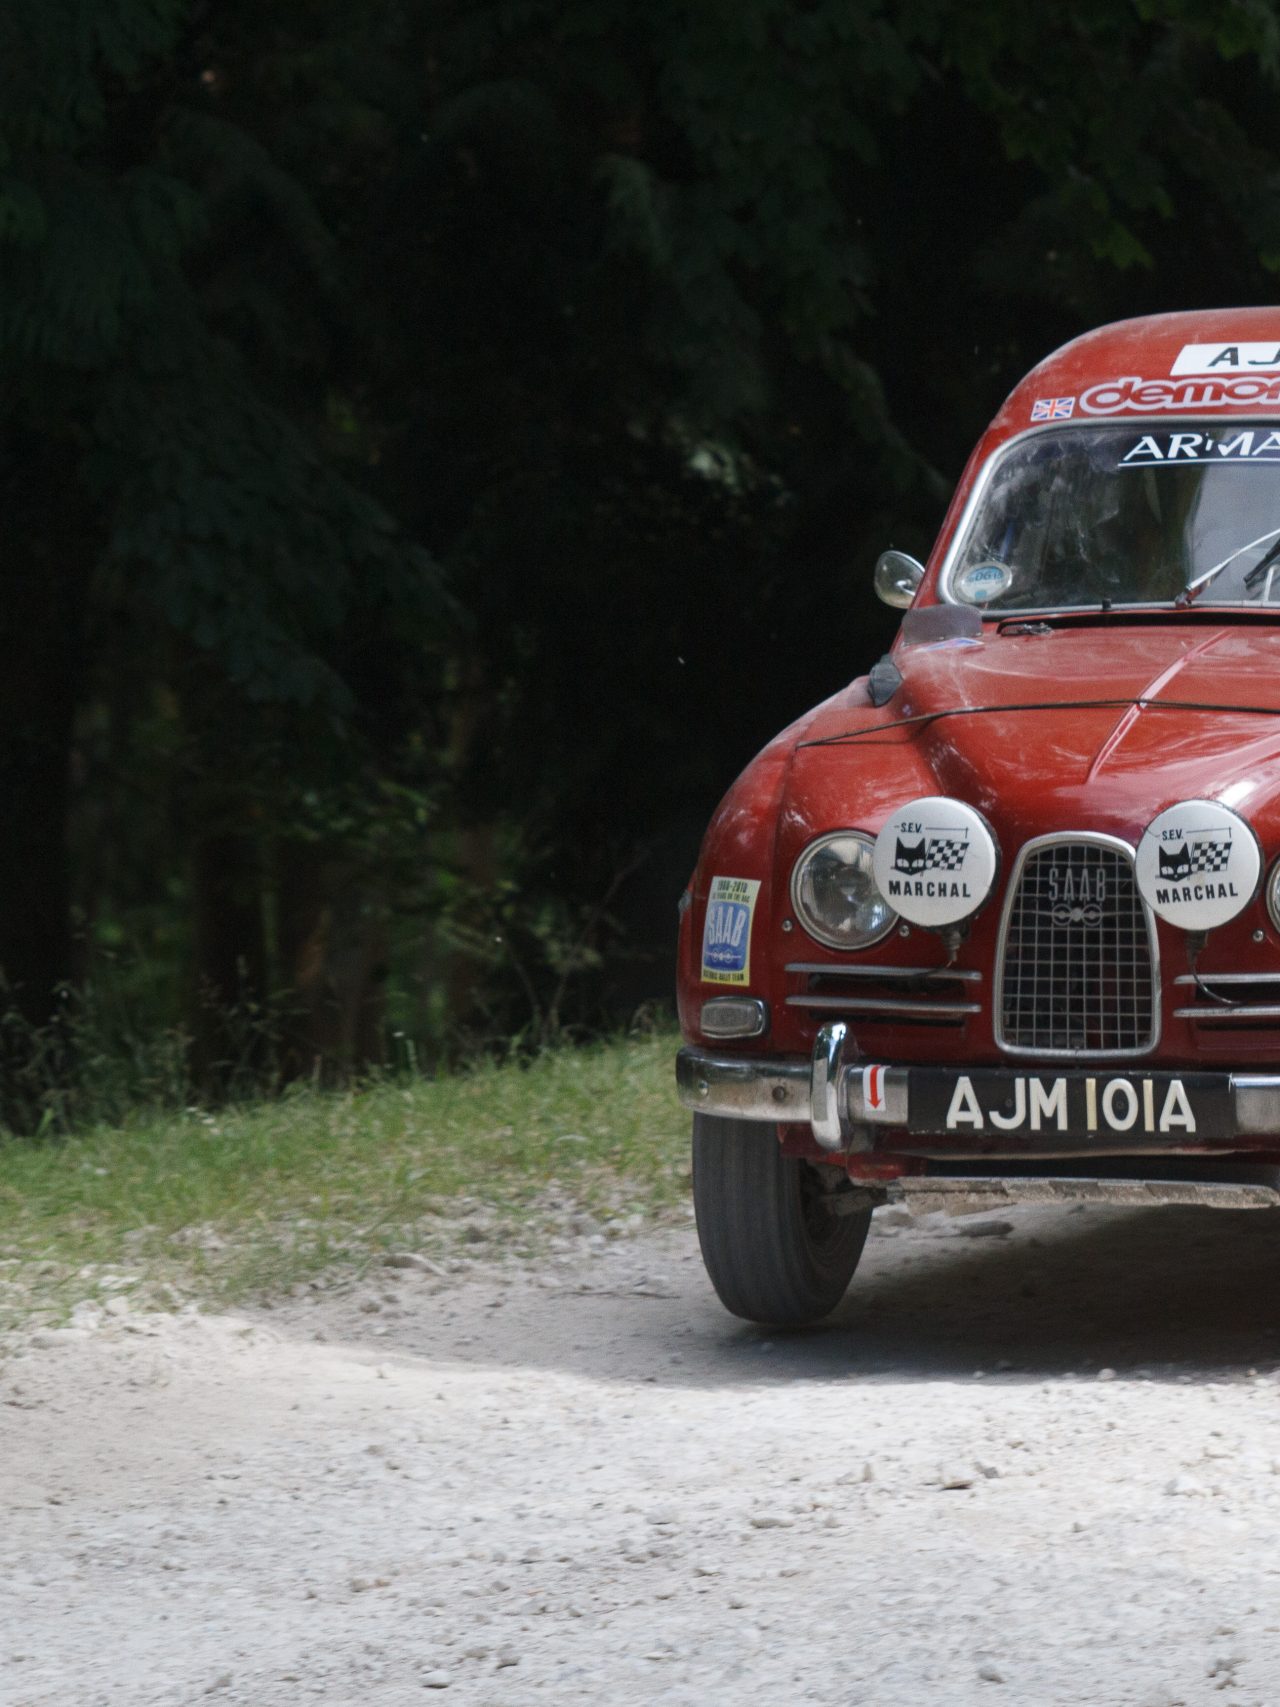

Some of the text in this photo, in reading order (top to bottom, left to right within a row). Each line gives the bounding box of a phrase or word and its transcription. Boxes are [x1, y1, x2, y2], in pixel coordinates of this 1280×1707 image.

[888, 880, 971, 898] MARCHAL
[1048, 867, 1106, 902] SAAB
[1156, 882, 1239, 904] MARCHAL
[708, 905, 747, 947] SAAB
[946, 1075, 1197, 1133] AJM 101A
